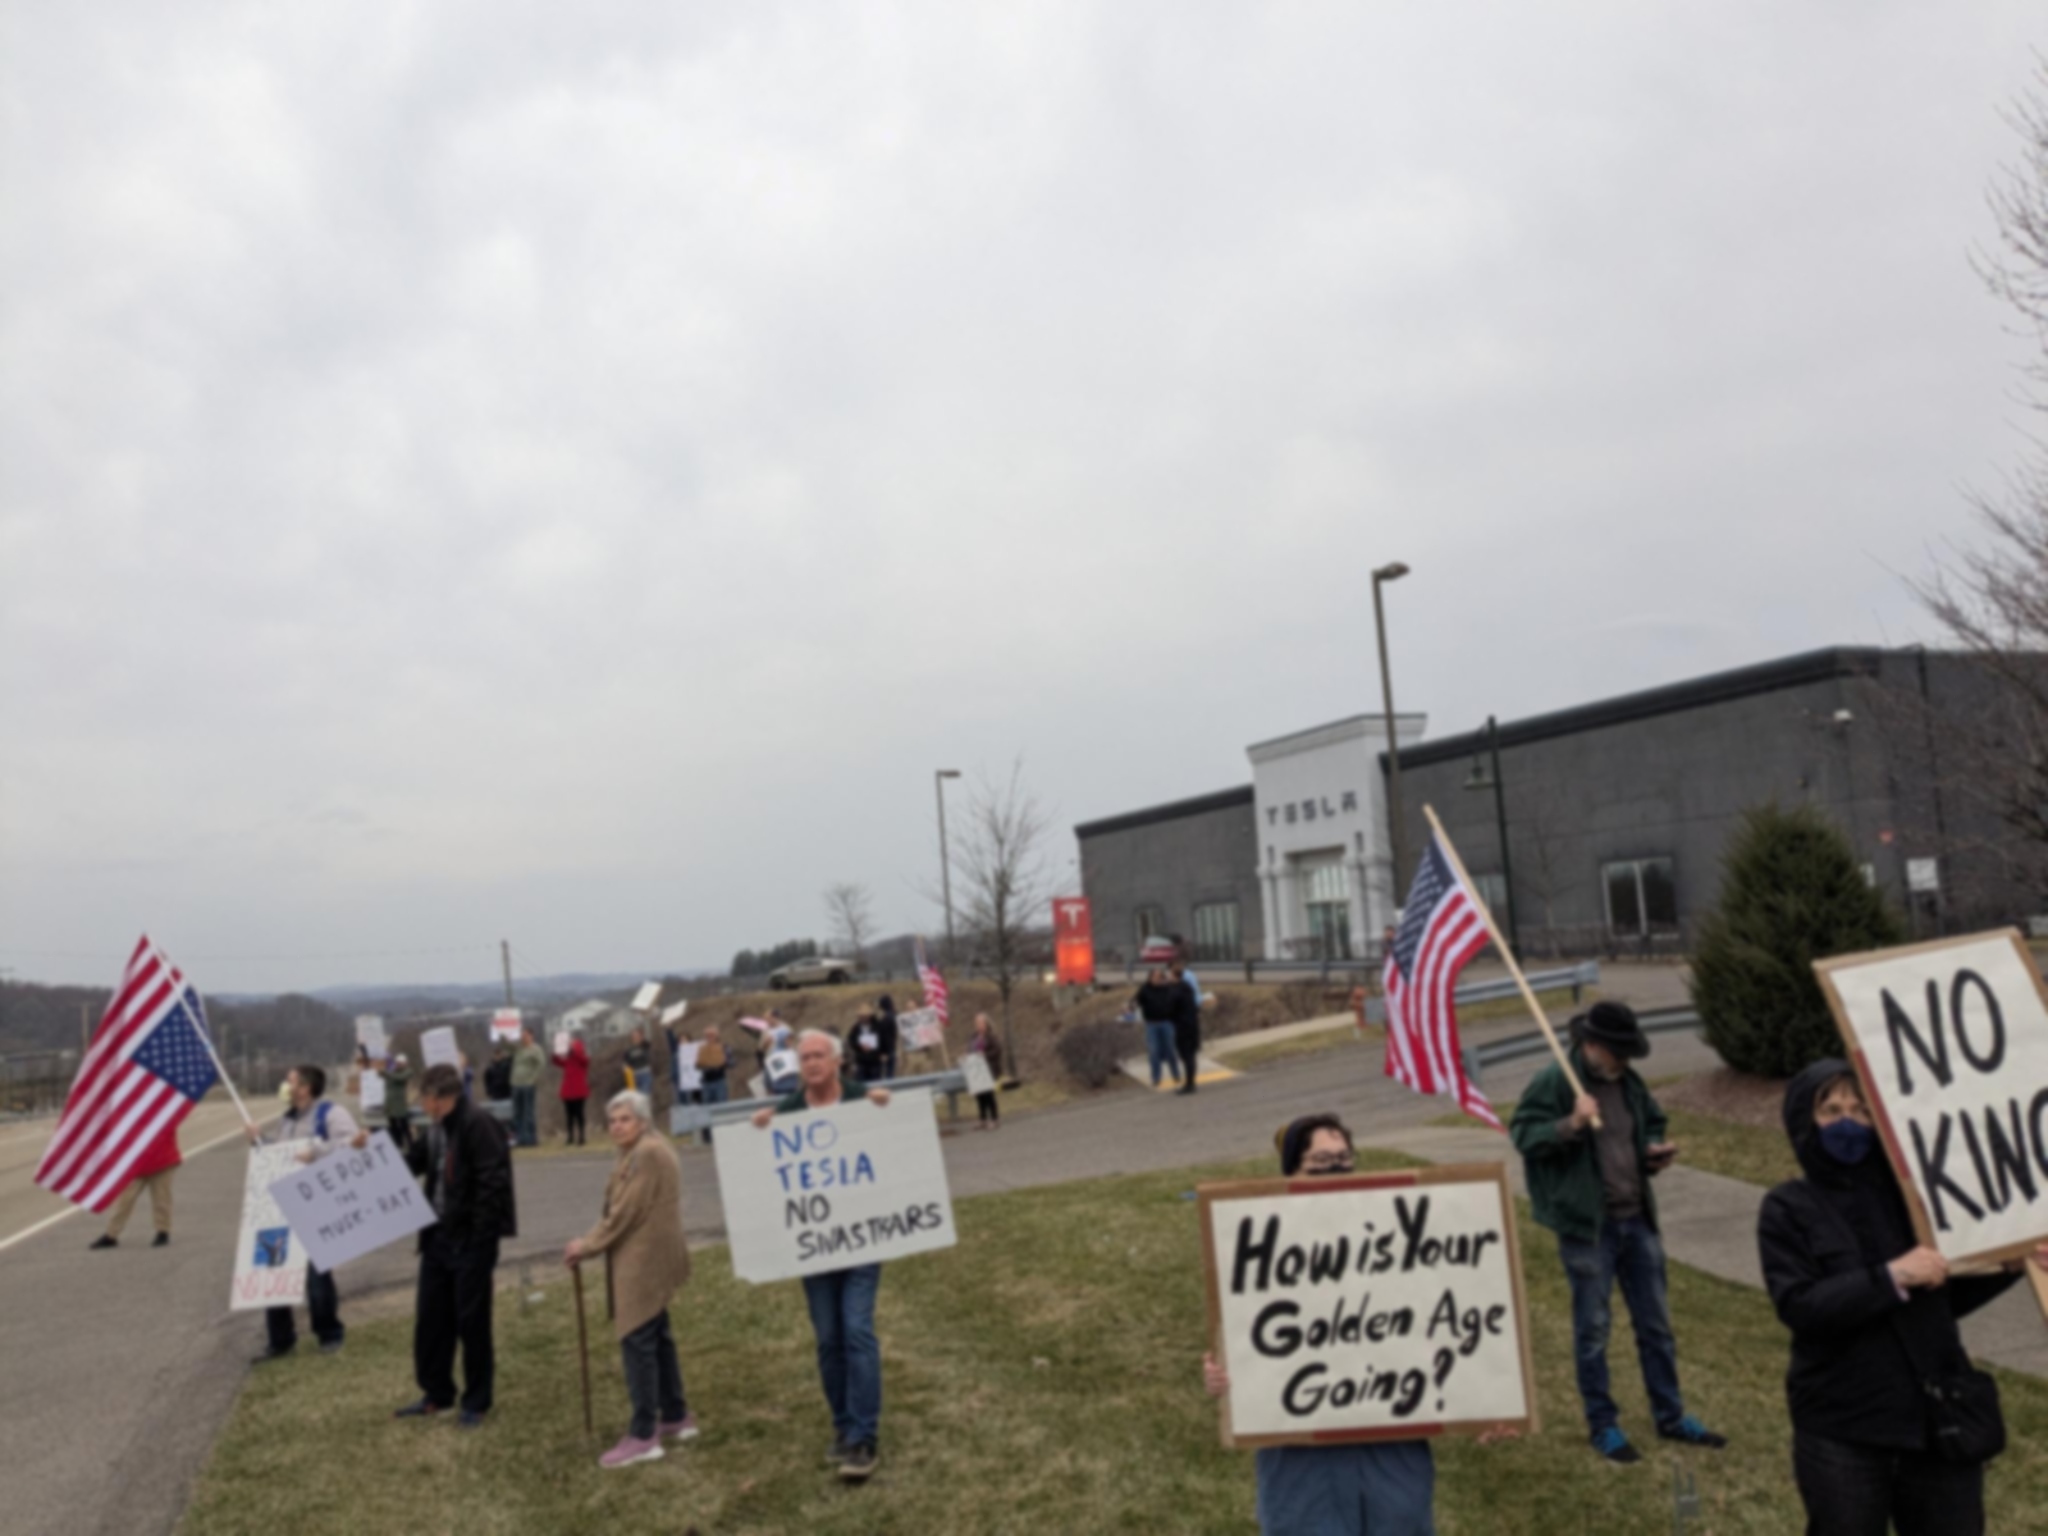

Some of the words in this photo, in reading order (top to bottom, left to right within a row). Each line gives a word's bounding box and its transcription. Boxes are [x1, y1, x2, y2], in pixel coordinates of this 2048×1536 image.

[1265, 789, 1358, 827] TESLA
[1880, 968, 2007, 1096] NO
[772, 1119, 838, 1159] NO
[297, 1143, 390, 1202] DEPORT
[775, 1151, 876, 1192] TESLA
[785, 1194, 831, 1229] NO
[1231, 1214, 1349, 1294] How
[1356, 1221, 1396, 1274] is
[1394, 1194, 1500, 1272] Your
[1251, 1292, 1415, 1358] Golden
[1426, 1288, 1506, 1357] Age
[1281, 1346, 1456, 1417] Going?
